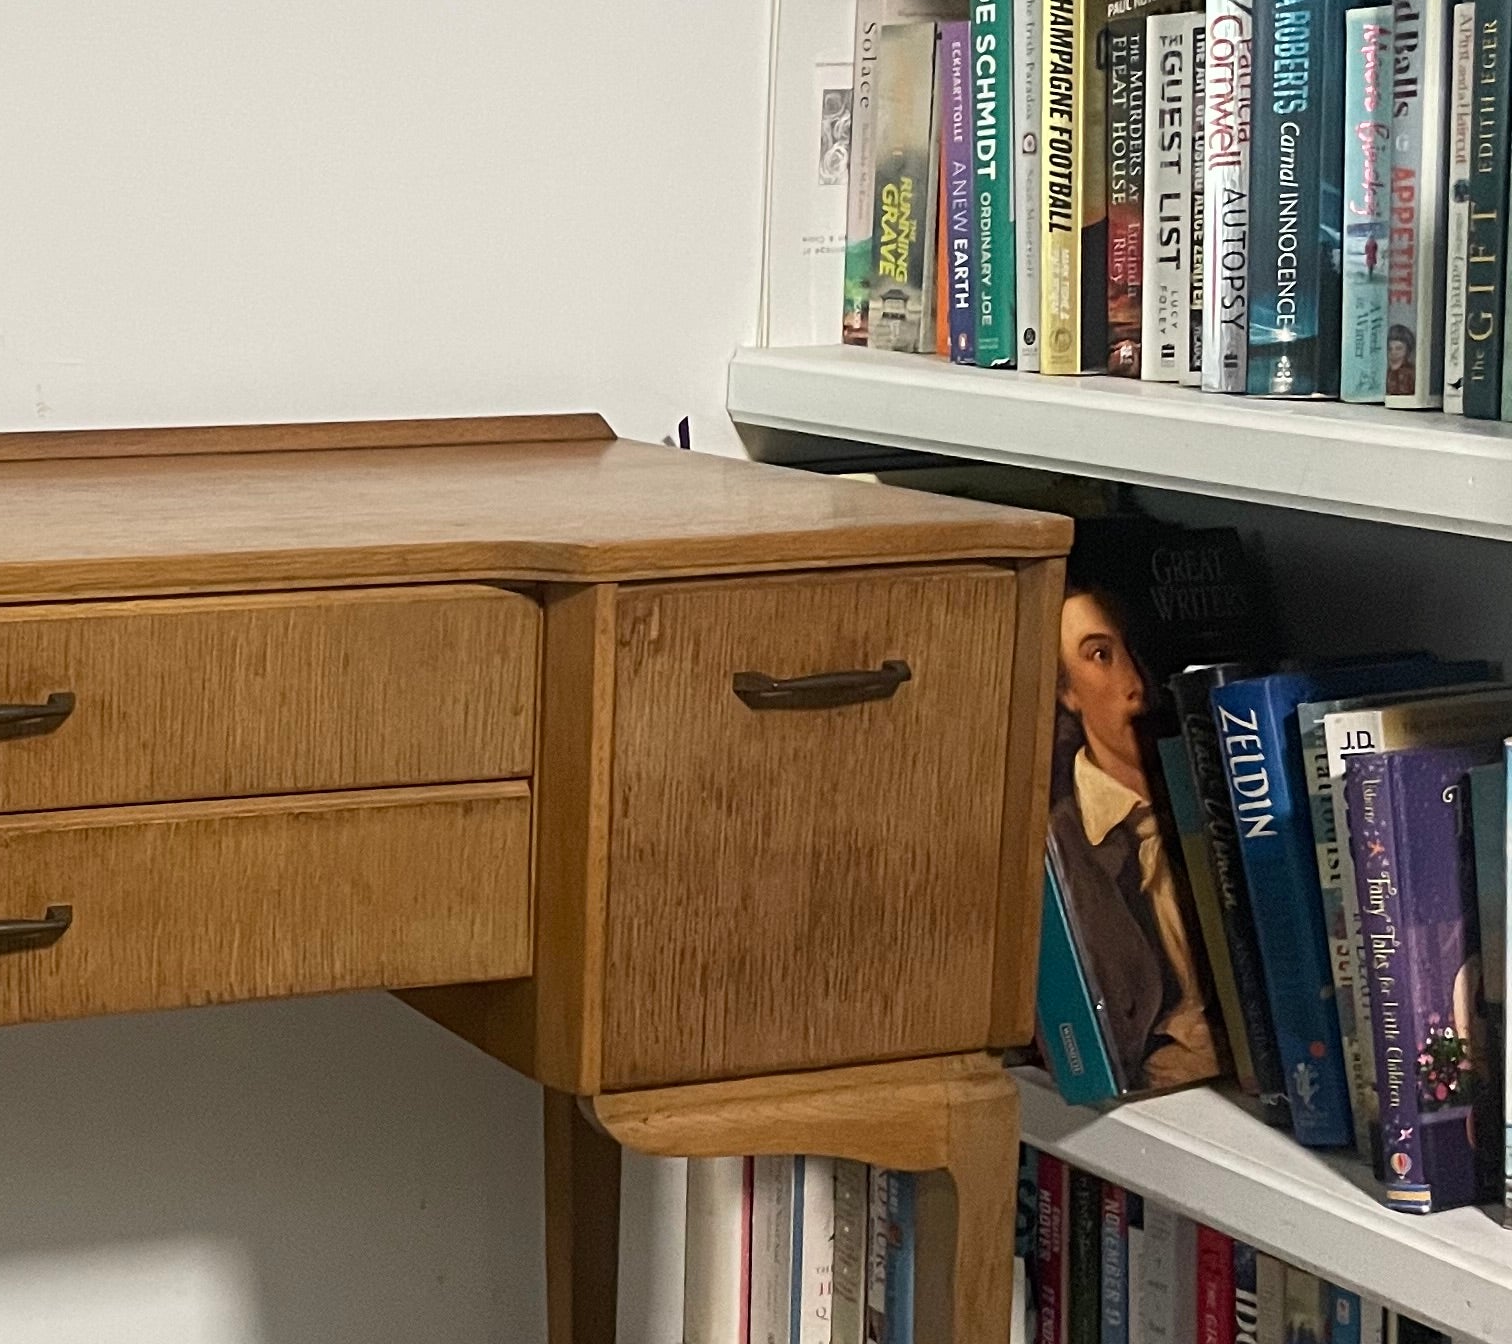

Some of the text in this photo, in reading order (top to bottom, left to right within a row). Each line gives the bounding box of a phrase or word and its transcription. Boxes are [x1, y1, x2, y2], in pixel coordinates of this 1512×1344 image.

[859, 21, 879, 110] Solace
[975, 34, 998, 182] SCHMIDT
[1129, 34, 1144, 177] THE MURDERS
[1272, 18, 1312, 116] ROBERTS
[1392, 24, 1419, 119] Balls
[1478, 19, 1498, 174] EDITH EGER
[1111, 36, 1128, 206] FLEAT HOUSE
[1158, 47, 1184, 271] GUEST LIST
[1207, 14, 1247, 331] Cornwell AUTOPSY
[1279, 121, 1301, 187] Carnal
[878, 182, 900, 279] GRAVE
[895, 175, 915, 284] RUNNING
[950, 41, 971, 311] ECKHART TOLLE A NEW EARTH
[1048, 125, 1073, 234] FOOTBALL
[980, 192, 992, 285] ORDINARY
[1109, 239, 1126, 285] Riley
[1125, 221, 1143, 298] Lucinda
[1275, 190, 1298, 330] INNOCENCE
[1387, 165, 1417, 305] APPETITE
[1467, 201, 1499, 342] GIFT
[981, 286, 994, 327] JOE
[1158, 284, 1169, 335] FOLEY
[1170, 288, 1180, 330] LUCY
[1217, 707, 1279, 841] ZELDIN
[1361, 777, 1404, 1109] Usborne Fairy Tales for Little Children
[1038, 1189, 1053, 1261] HOOVER
[1104, 1198, 1123, 1303] NOVEMBER
